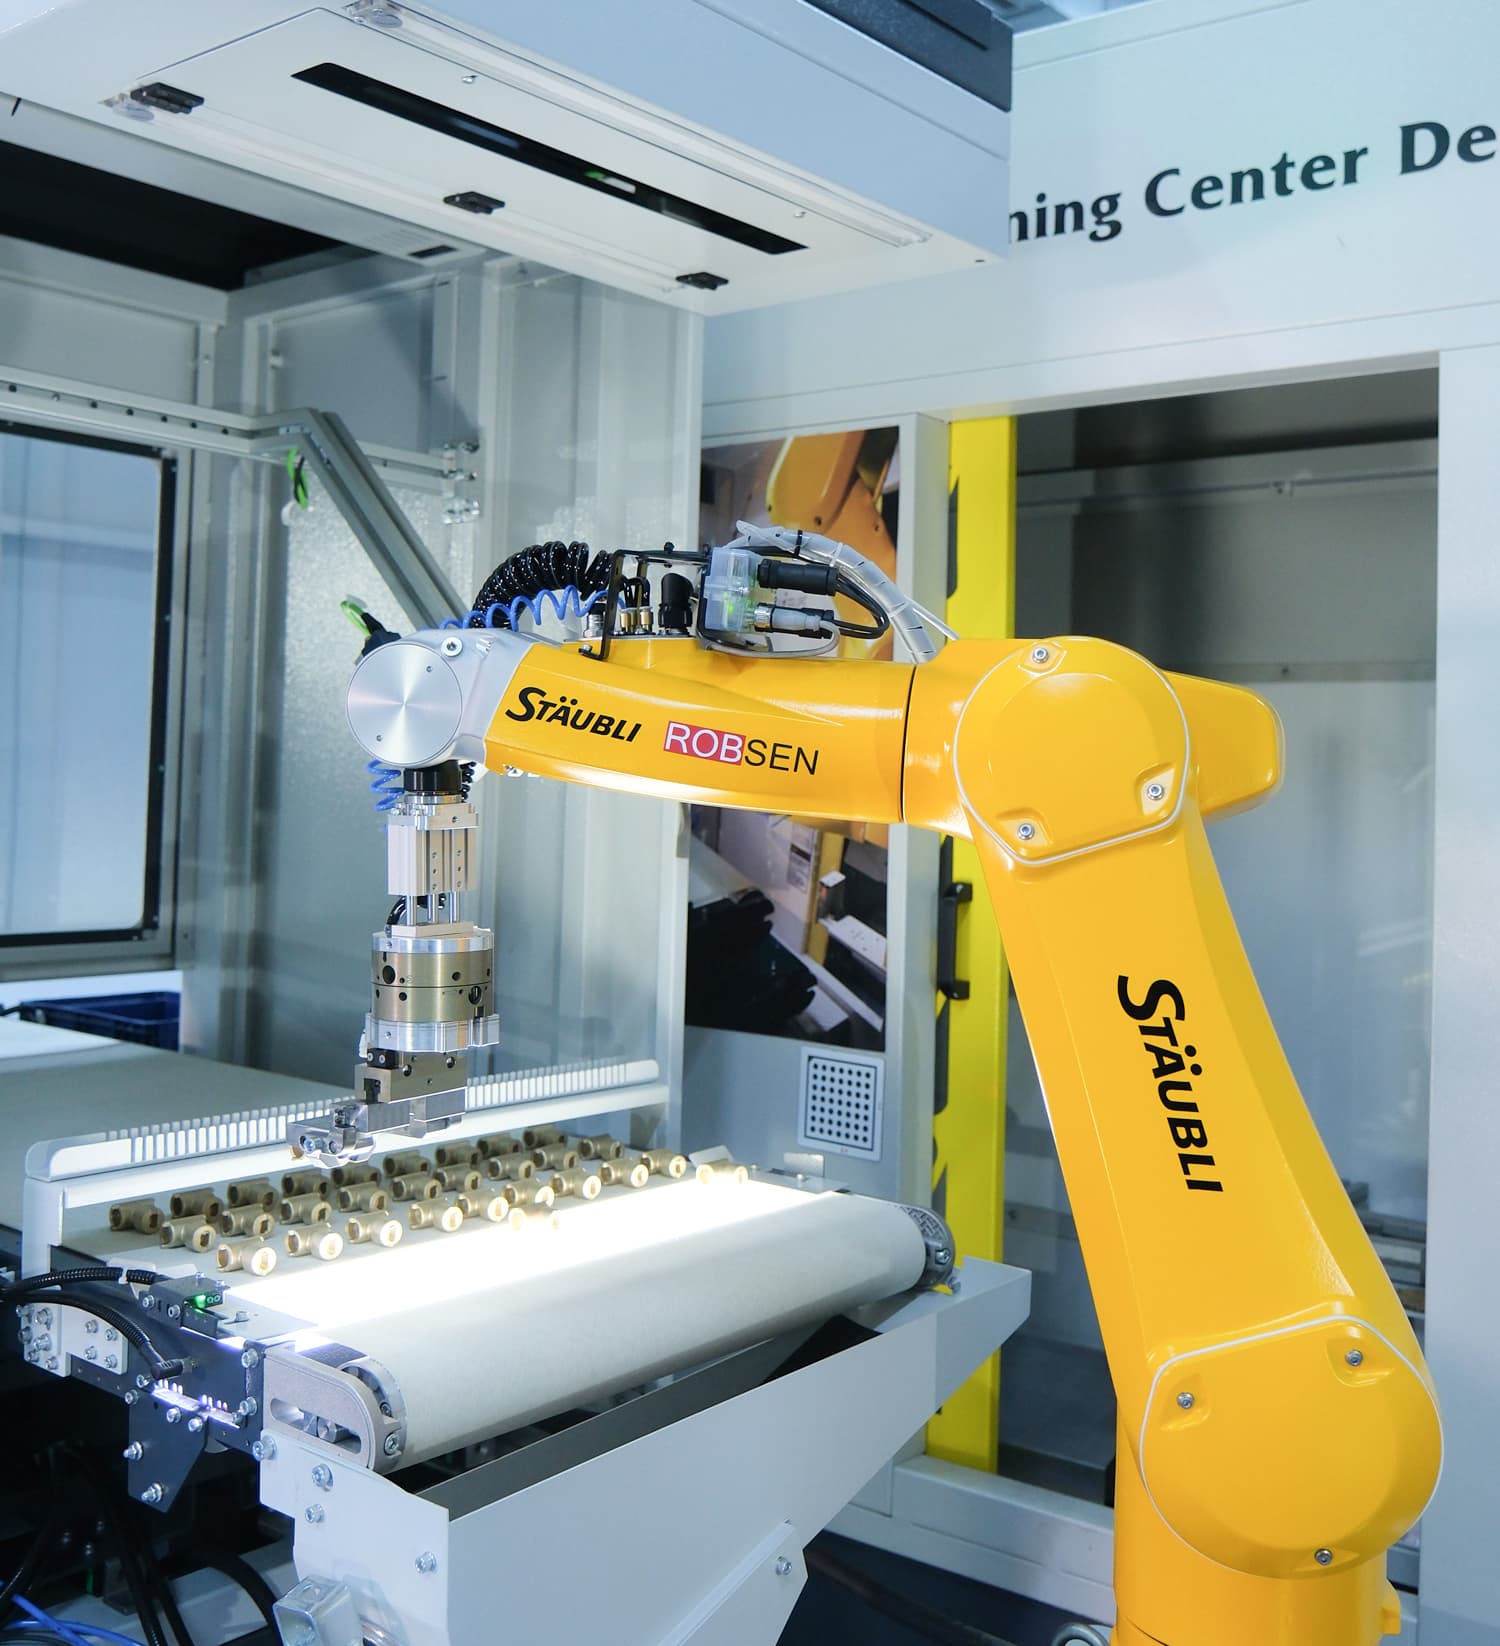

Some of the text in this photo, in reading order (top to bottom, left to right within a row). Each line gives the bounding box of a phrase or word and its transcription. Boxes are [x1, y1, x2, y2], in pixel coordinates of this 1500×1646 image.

[1144, 146, 1369, 217] Center
[1399, 121, 1497, 176] De
[505, 686, 819, 776] STÄUBLI ROBSEN
[1117, 975, 1224, 1192] STÄUBLI
